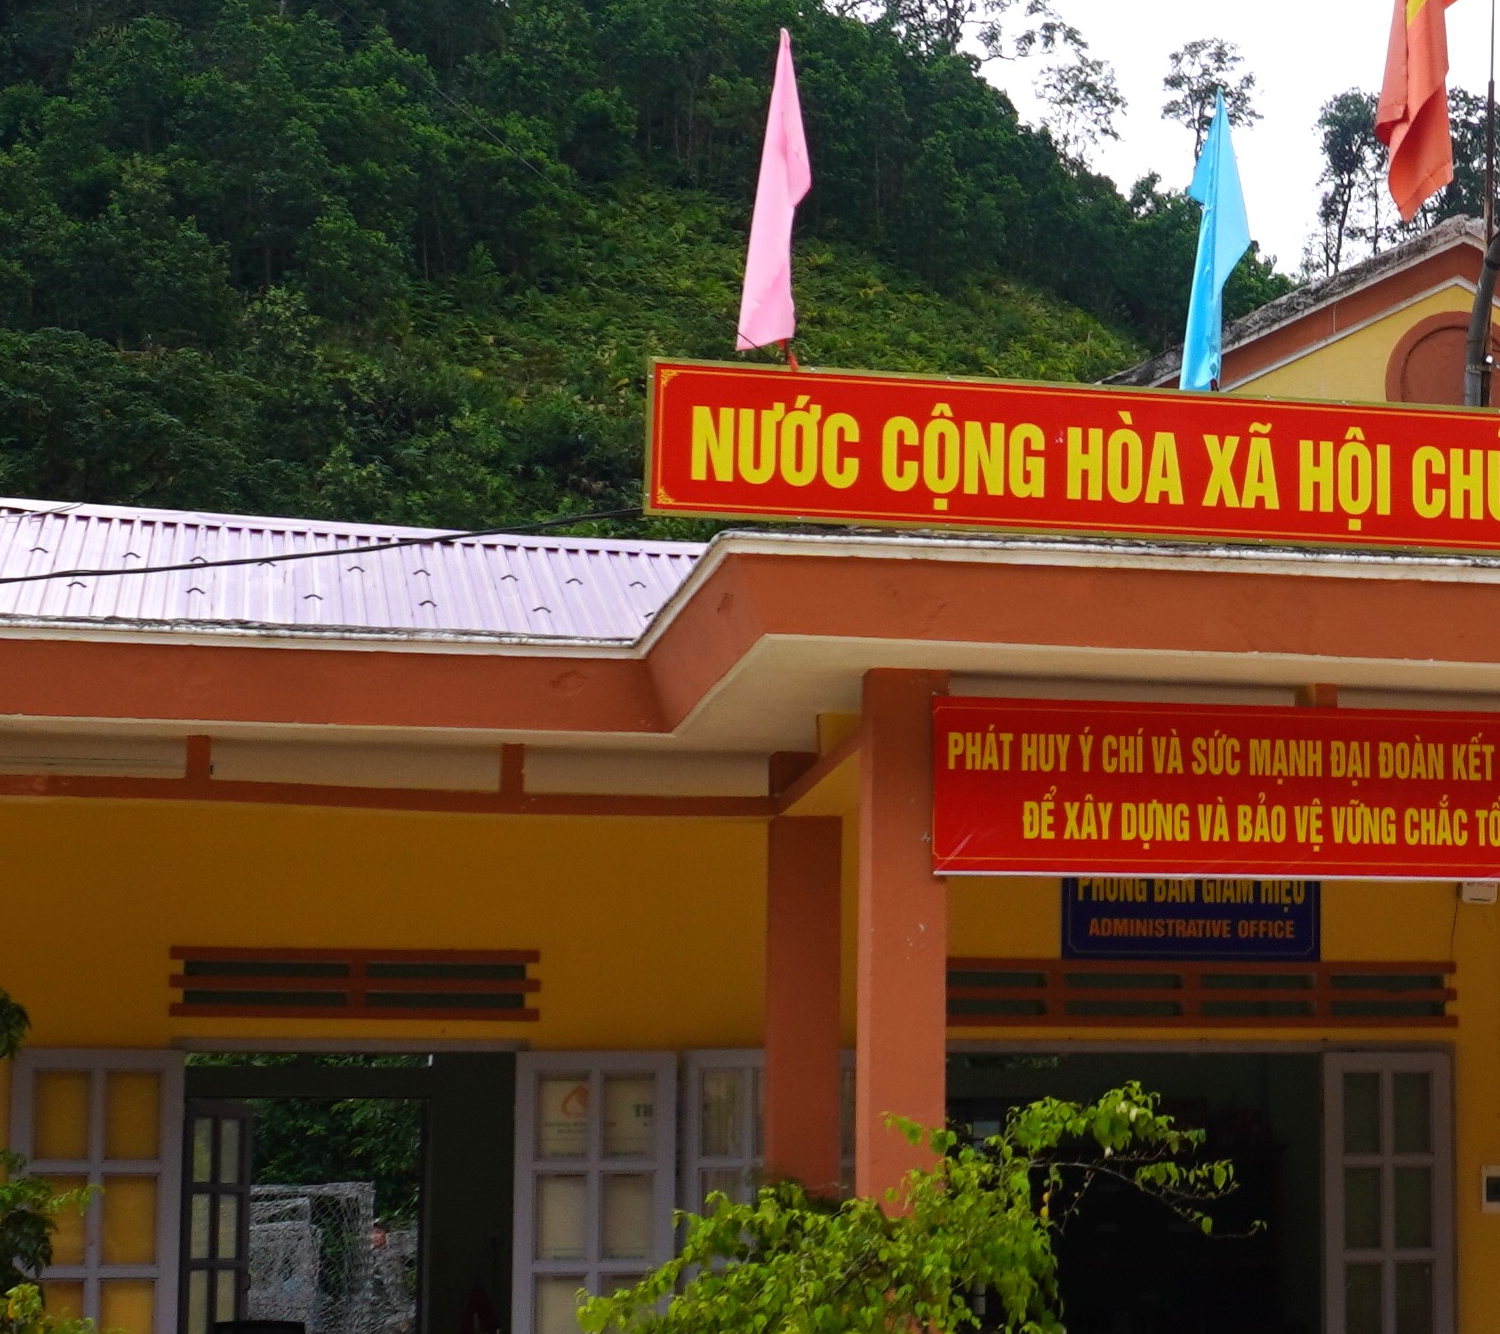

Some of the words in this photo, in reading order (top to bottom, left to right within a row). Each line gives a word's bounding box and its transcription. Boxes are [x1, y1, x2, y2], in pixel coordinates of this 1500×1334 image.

[691, 395, 859, 488] NƯỚC
[882, 403, 1045, 510] CỘNG
[1067, 411, 1184, 504] HÒA
[1202, 419, 1279, 509] XÃ
[1300, 427, 1390, 530] HỘI
[948, 724, 1013, 770] PHÁT
[1021, 734, 1070, 771] HUY
[1079, 726, 1093, 772] Ý
[1102, 728, 1143, 773] CHÍ
[1152, 729, 1184, 774] VÀ
[1192, 730, 1240, 775] SỨC
[1250, 739, 1322, 784] MẠNH
[1330, 741, 1370, 786] ĐẠI
[1378, 735, 1444, 779] ĐOÀN
[1453, 732, 1494, 780] KẾT
[1023, 786, 1056, 839] ĐỂ
[1064, 794, 1113, 840] XÂY
[1121, 799, 1190, 849] DỰNG
[1198, 797, 1230, 842] VÀ
[1237, 792, 1286, 843] BẢO
[1294, 798, 1323, 852] VỆ
[1331, 799, 1397, 845] VỮNG
[1404, 795, 1468, 846] CHẮC
[1088, 918, 1232, 938] ADMINISTRATIVE
[1237, 920, 1295, 939] OFFICE
